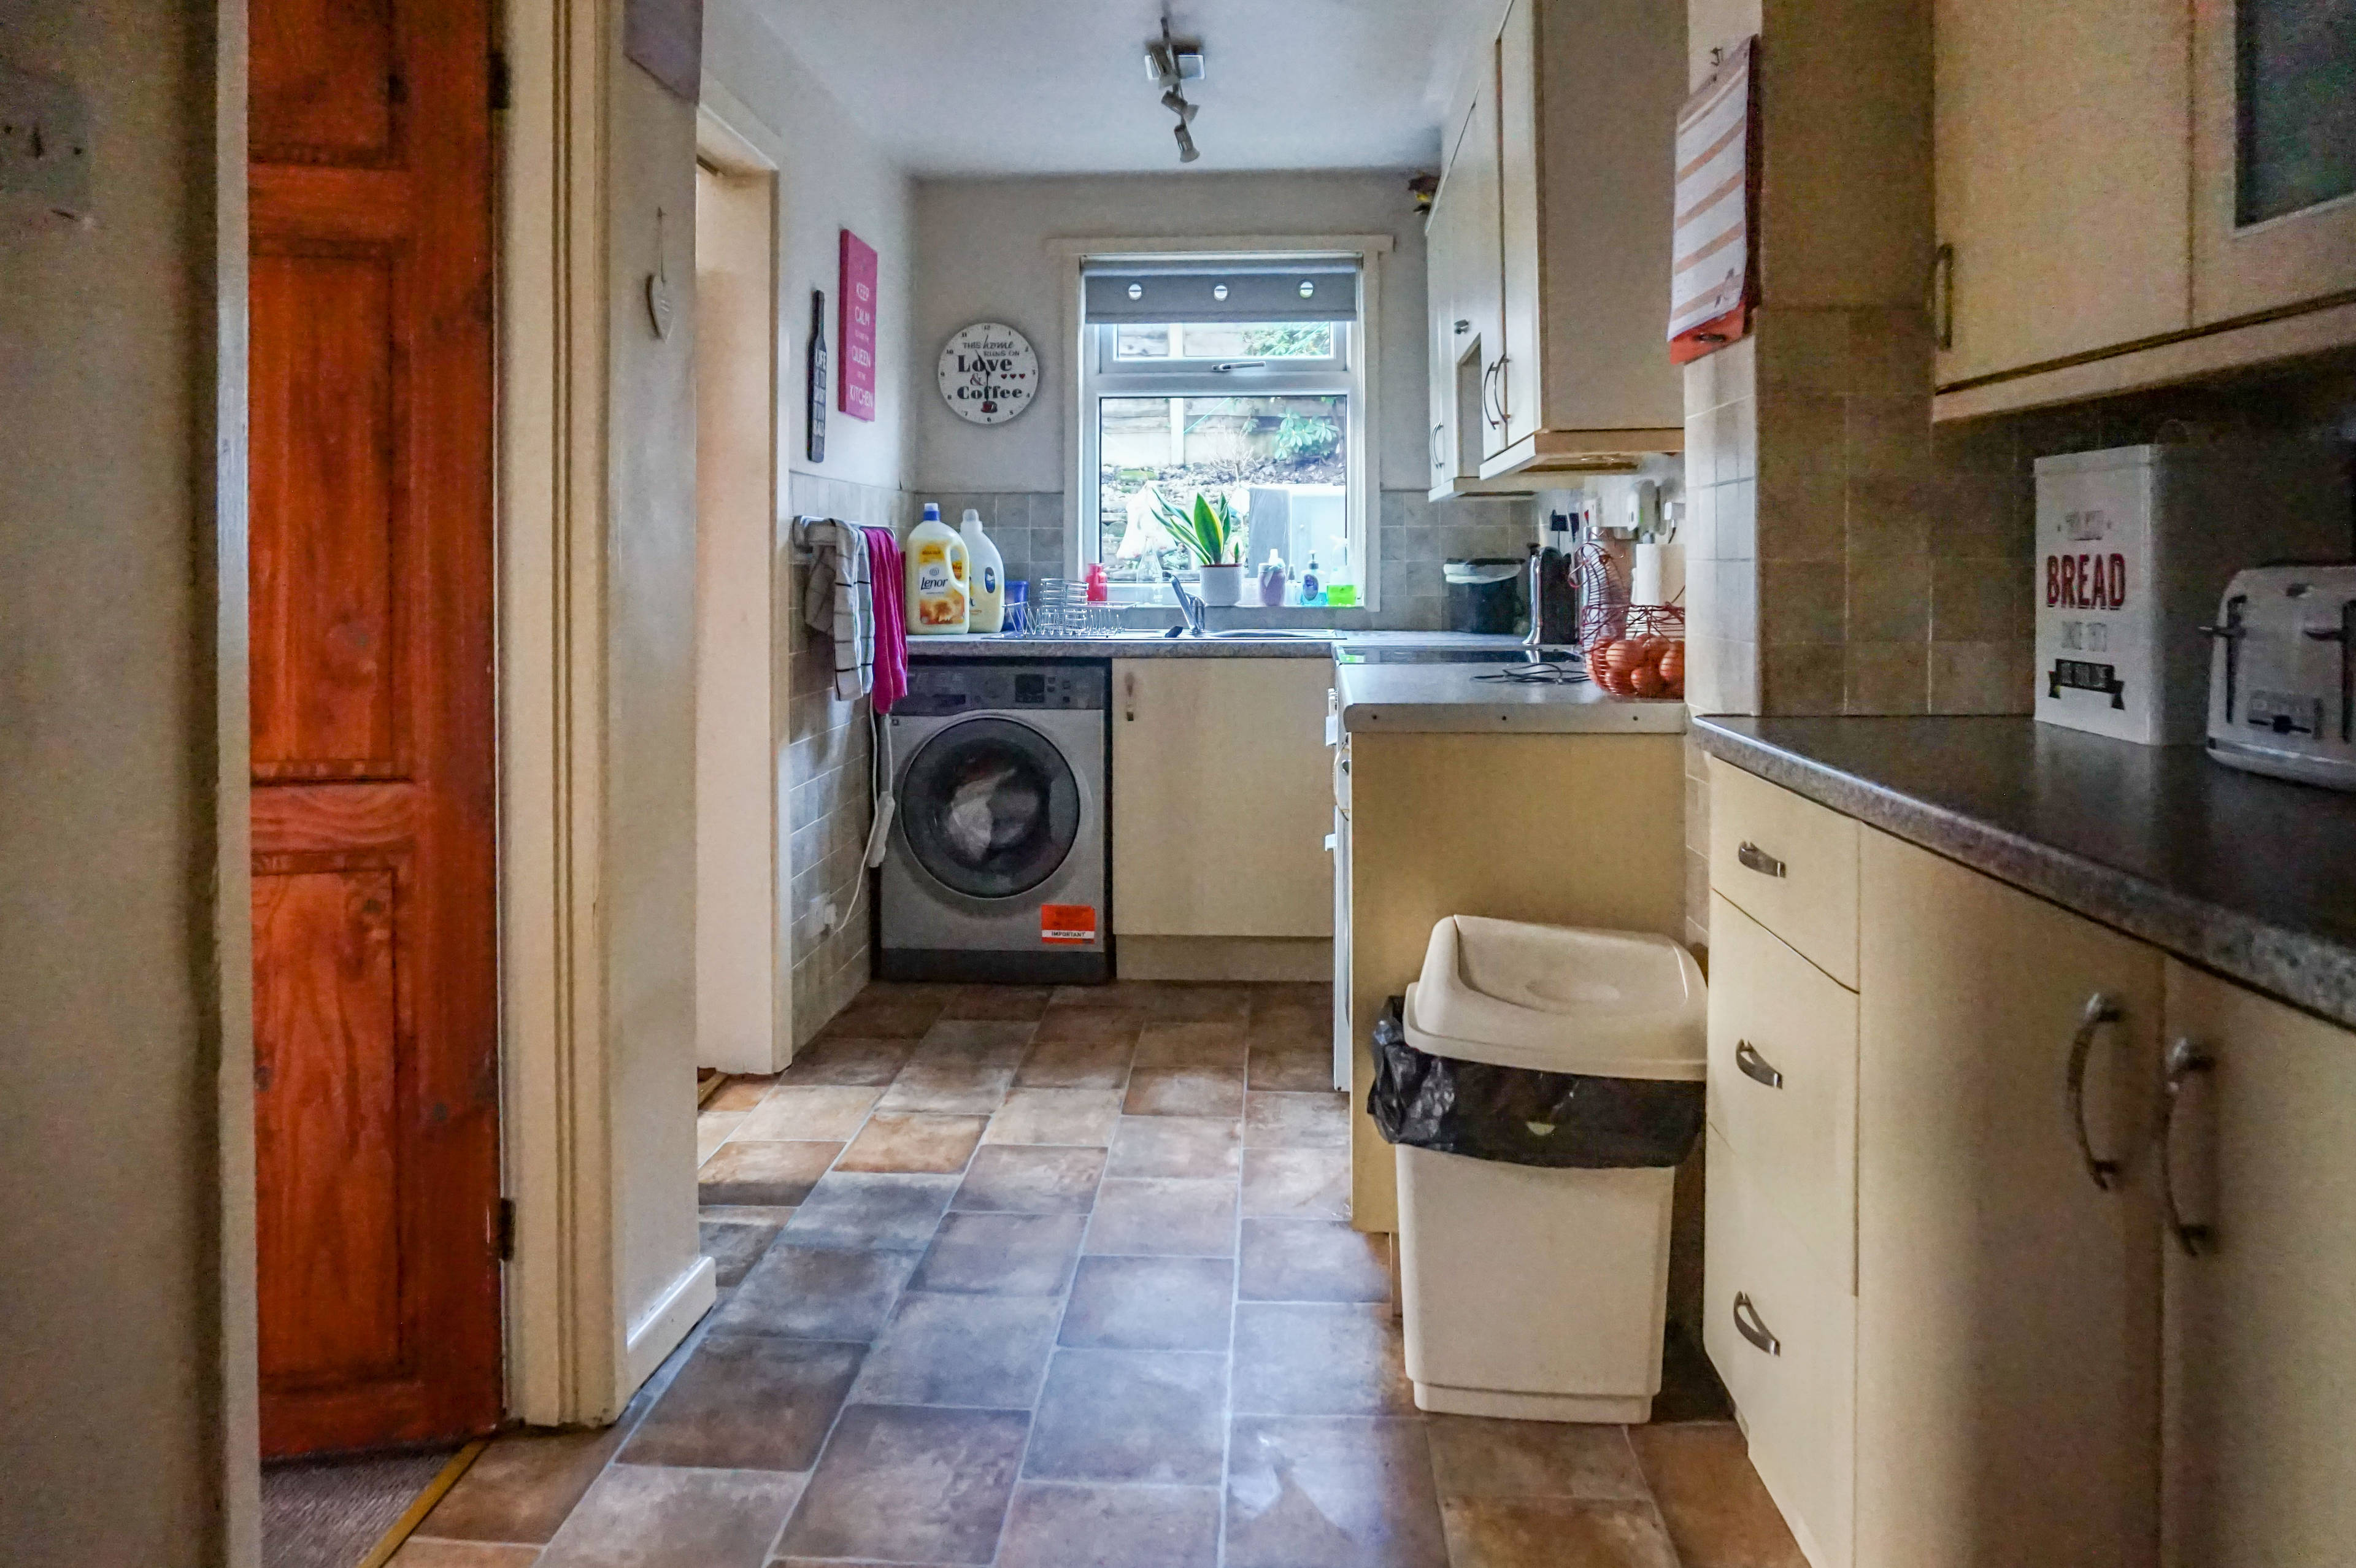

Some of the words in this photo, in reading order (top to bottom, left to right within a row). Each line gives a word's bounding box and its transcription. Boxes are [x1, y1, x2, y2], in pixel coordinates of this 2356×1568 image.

[958, 355, 1012, 372] Love
[970, 373, 984, 386] &
[850, 383, 873, 408] KITCHEN
[957, 386, 1022, 399] Coffee
[920, 577, 949, 590] Lenor
[2046, 553, 2126, 609] BREAD
